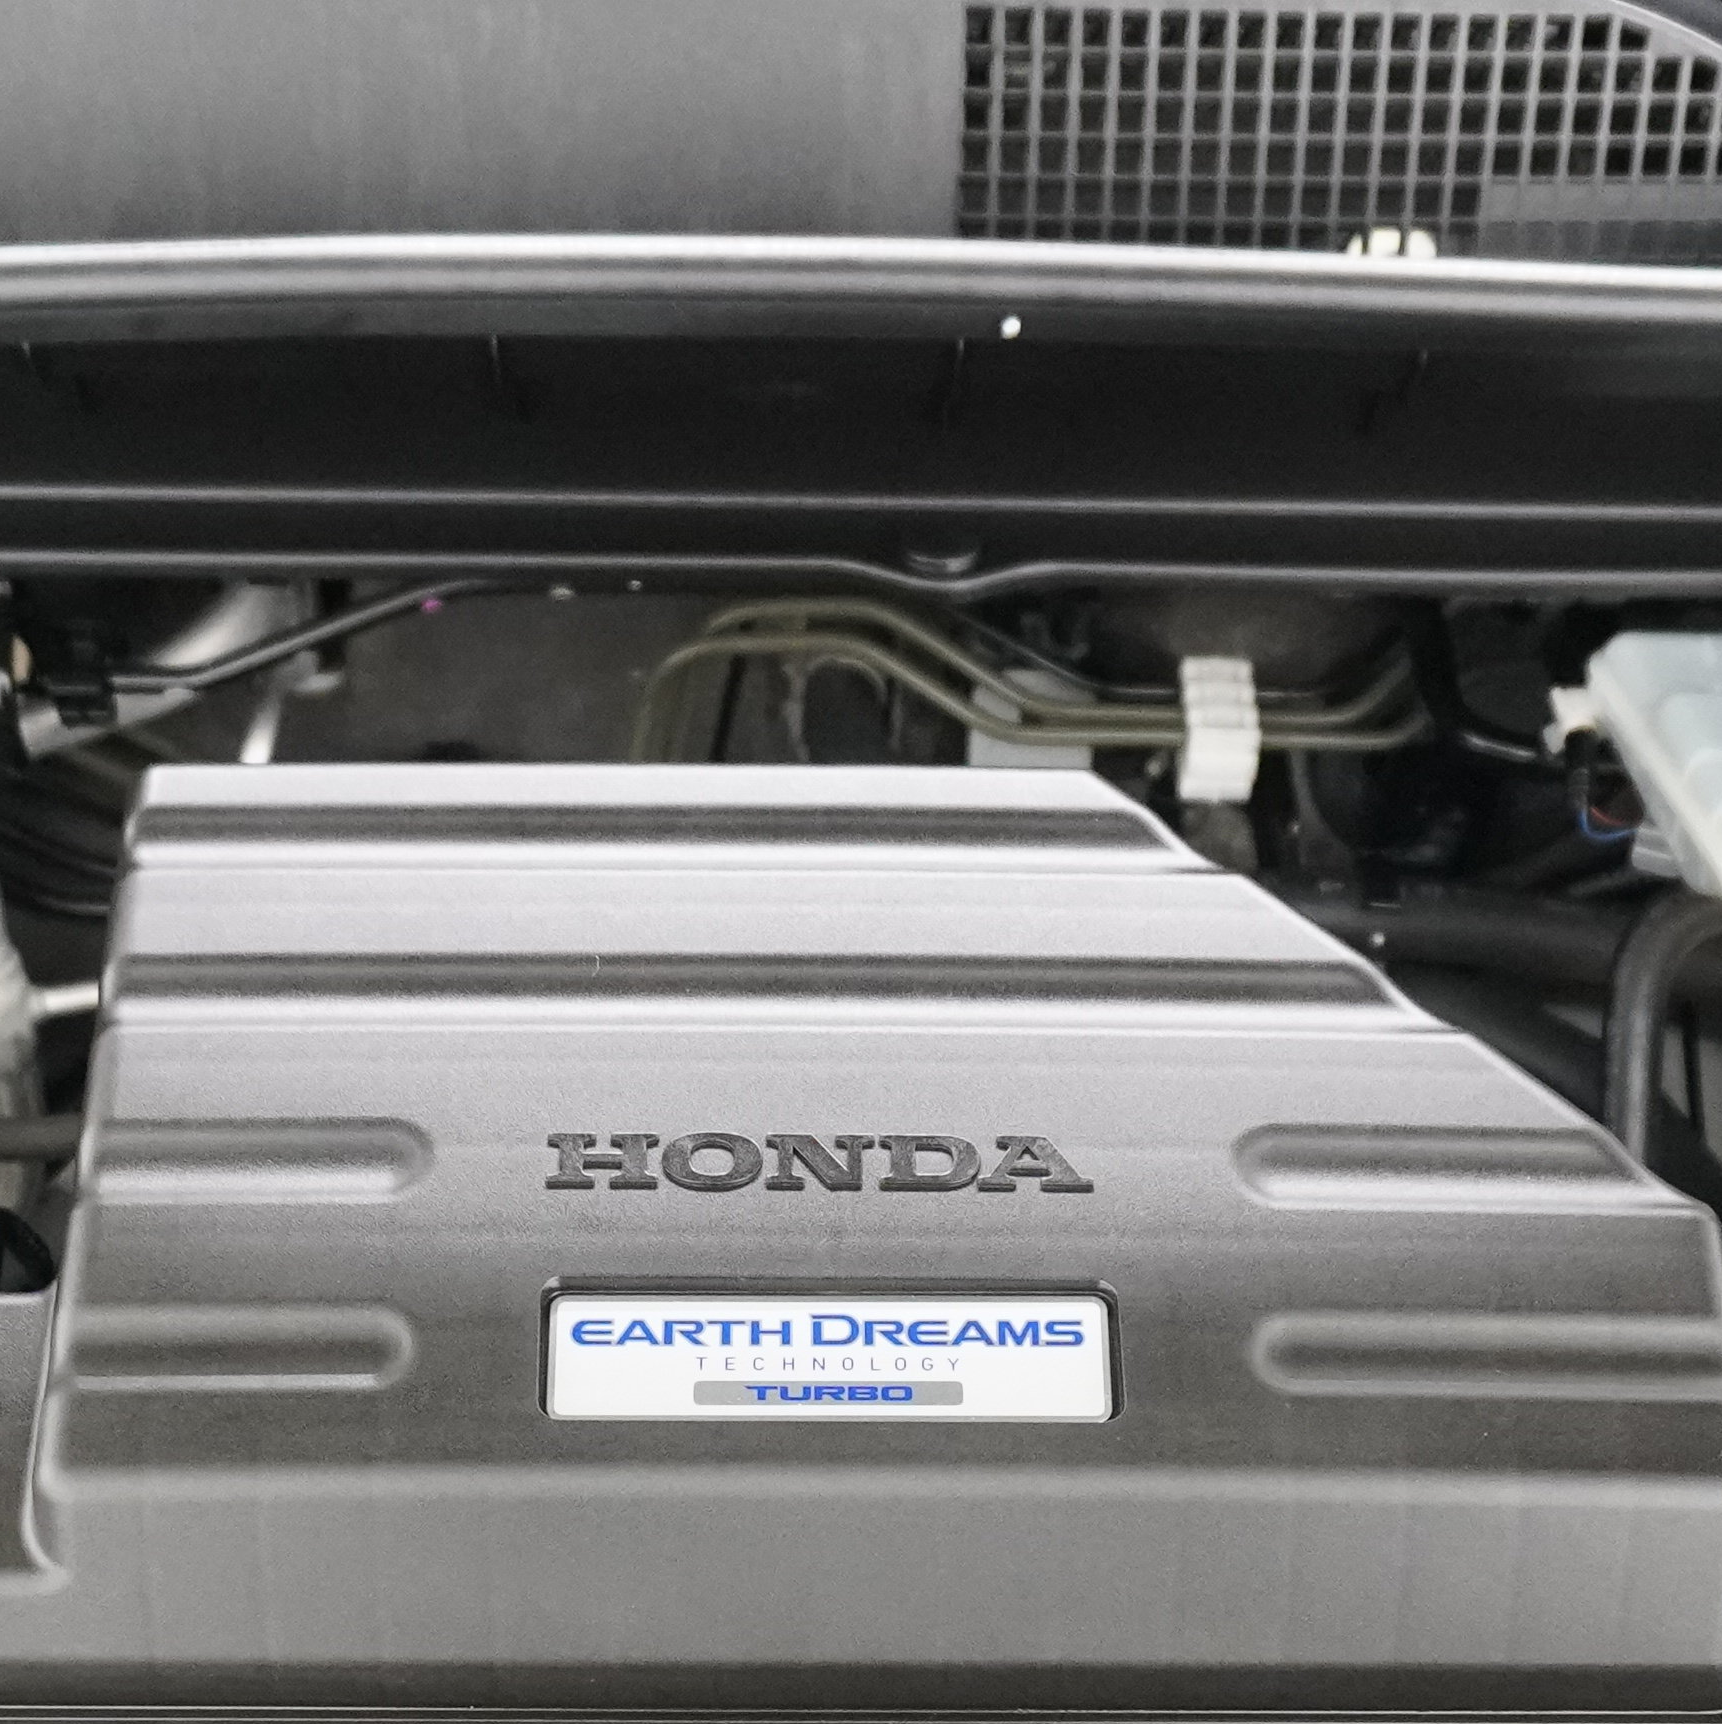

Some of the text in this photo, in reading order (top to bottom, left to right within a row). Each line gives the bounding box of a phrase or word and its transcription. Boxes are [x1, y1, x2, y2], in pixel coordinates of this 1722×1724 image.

[545, 1132, 1094, 1193] HONDA
[571, 1314, 1086, 1348] EARTH DREAMS
[695, 1356, 962, 1372] TECHNOLOGY
[744, 1384, 914, 1402] TURBO
